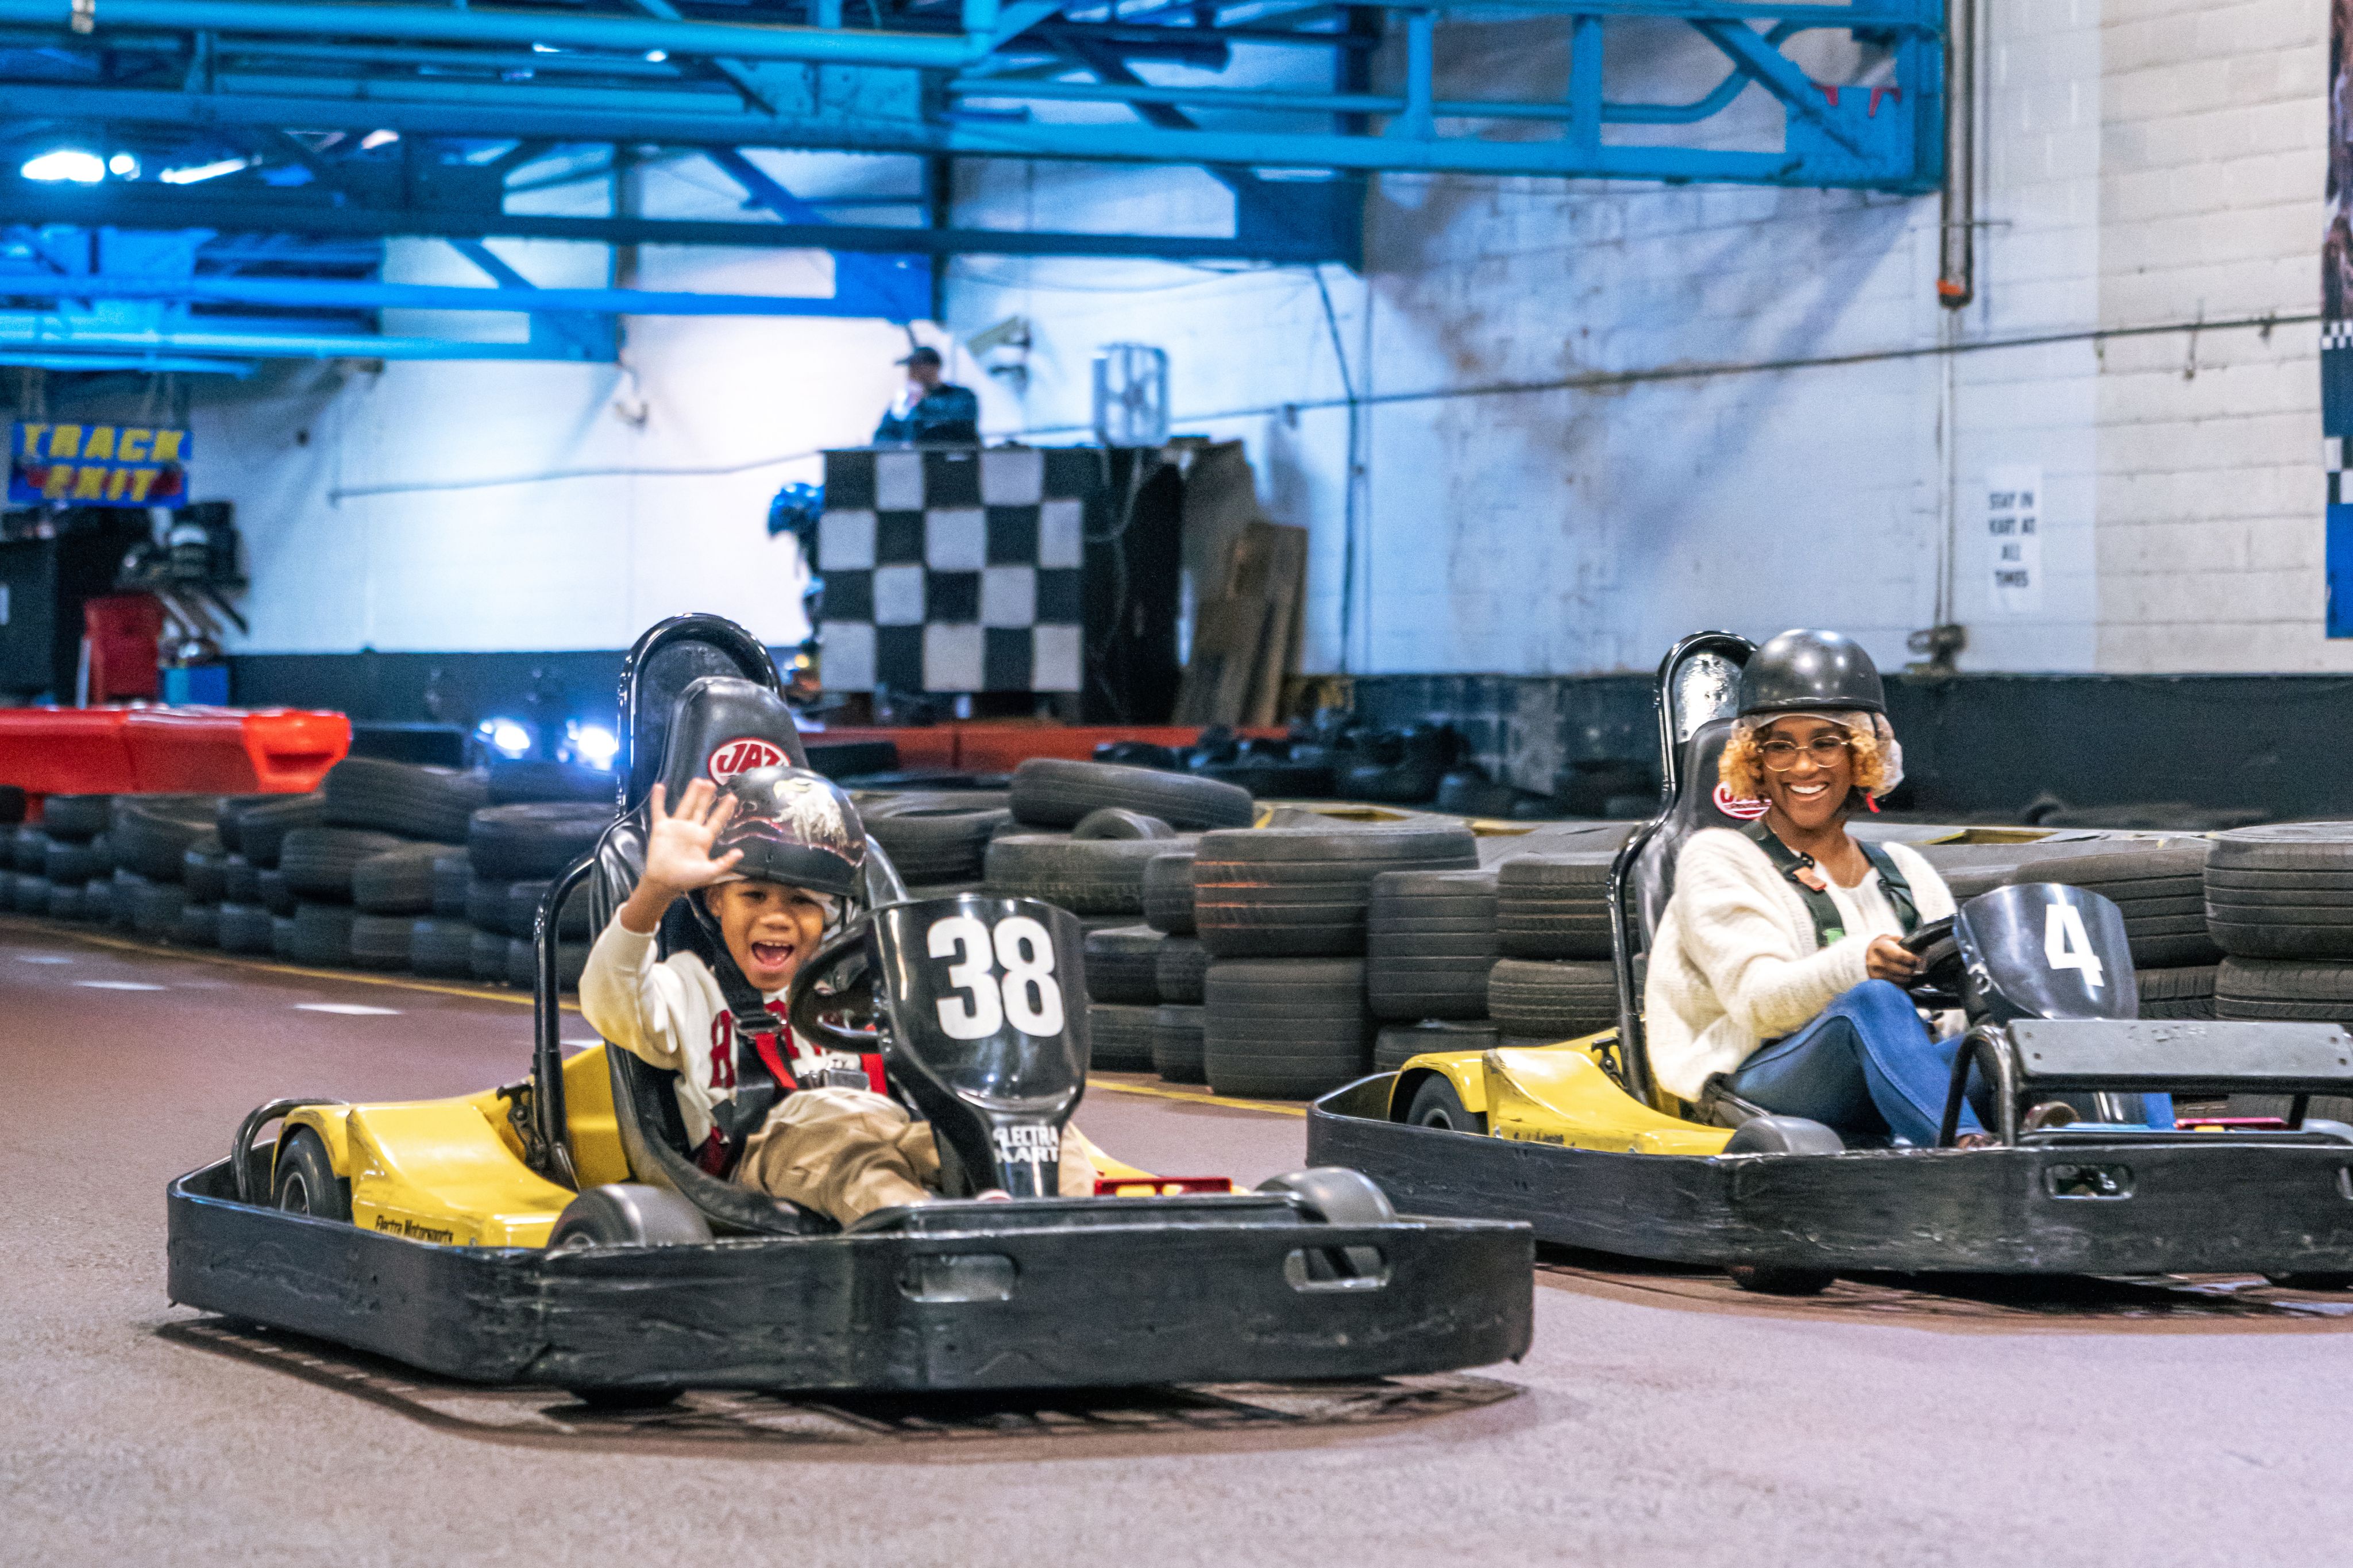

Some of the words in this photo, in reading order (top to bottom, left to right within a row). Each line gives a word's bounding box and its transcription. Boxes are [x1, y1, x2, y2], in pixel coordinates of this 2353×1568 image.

[24, 424, 183, 462] TRACK
[42, 465, 158, 502] EXIT
[2044, 903, 2105, 987] 4
[927, 916, 1064, 1040] 38
